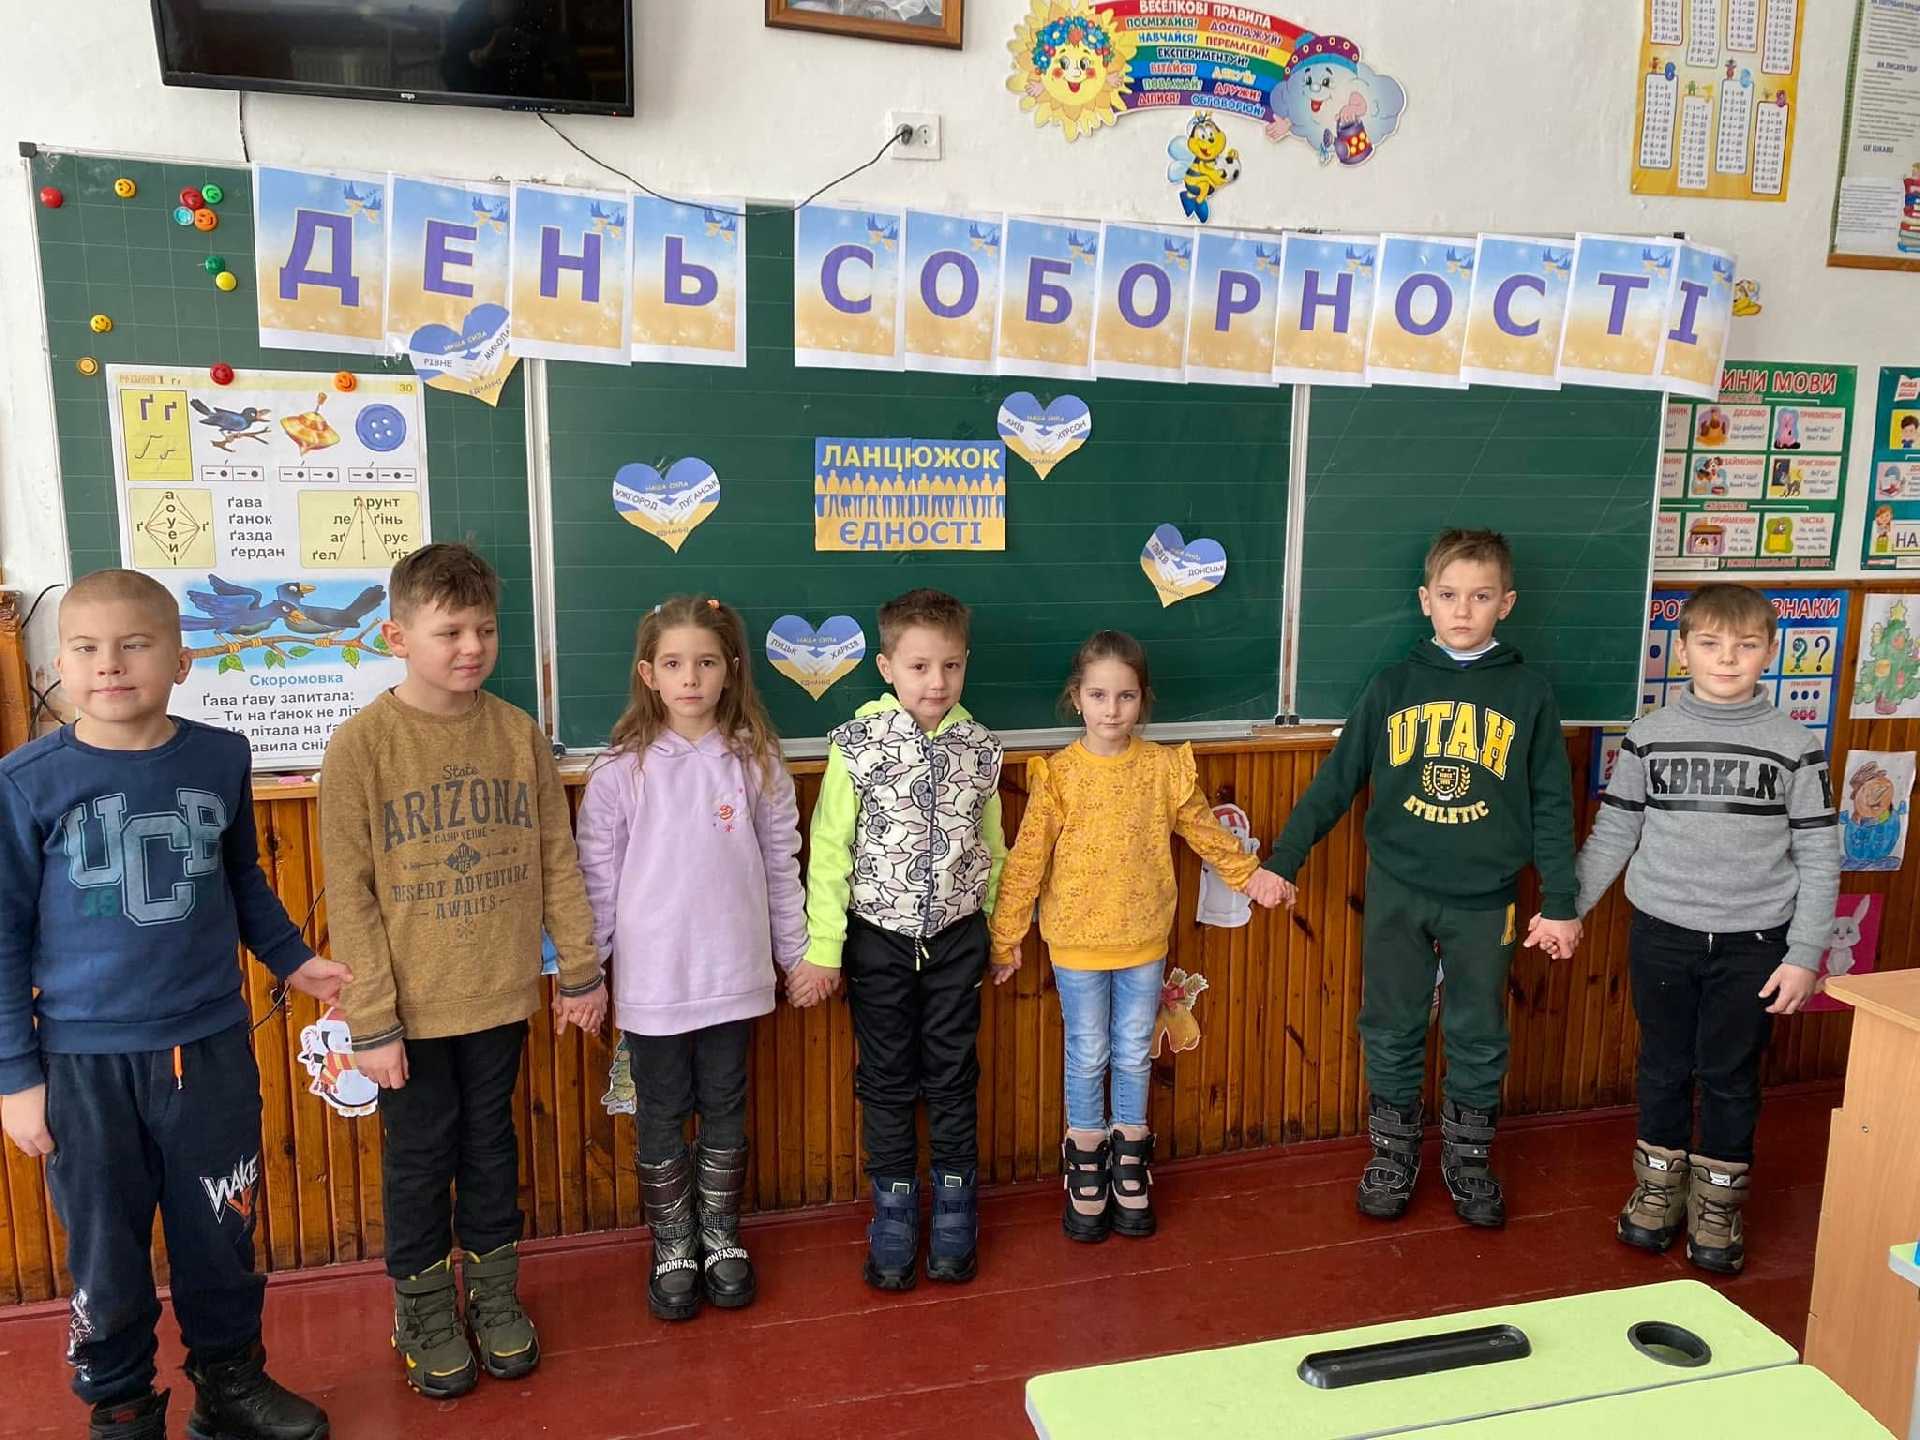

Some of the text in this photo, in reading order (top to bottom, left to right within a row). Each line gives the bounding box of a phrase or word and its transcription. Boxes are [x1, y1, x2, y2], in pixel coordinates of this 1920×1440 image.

[1126, 16, 1198, 29] ПОСМІХАЙСЯ!
[1139, 0, 1272, 28] ВЕСЕЛКОВІ ПРАВИЛА
[1138, 32, 1198, 44] НАВЧАЙСЯ!
[279, 209, 1709, 346] ДЕНЬ СОБОРНОСТІ
[1772, 371, 1837, 394] МОВИ
[822, 445, 1000, 473] ЛАНЦЮЖОК
[228, 496, 262, 508] ґава
[228, 513, 272, 525] ґанок
[230, 530, 272, 541] ґазда
[839, 521, 982, 549] ЄДНОСТІ
[231, 546, 285, 559] ґердан
[1650, 598, 1841, 621] РО ЗНАКИ
[250, 674, 344, 688] Скоромовка
[203, 690, 354, 706] Ґава ґаву запитала:
[224, 711, 242, 722] Ти
[248, 711, 266, 721] на
[270, 708, 313, 720] ґанок
[317, 708, 334, 717] не
[250, 724, 299, 736] літала
[304, 725, 321, 734] на
[1388, 701, 1516, 781] UTAH
[1649, 759, 1779, 800] KBRKLN
[383, 778, 533, 853] ARIZONA
[1403, 794, 1489, 824] ATHLETIC
[454, 863, 529, 896] ADVENTURE
[435, 894, 497, 919] AWAITS
[199, 1150, 259, 1224] WAKE
